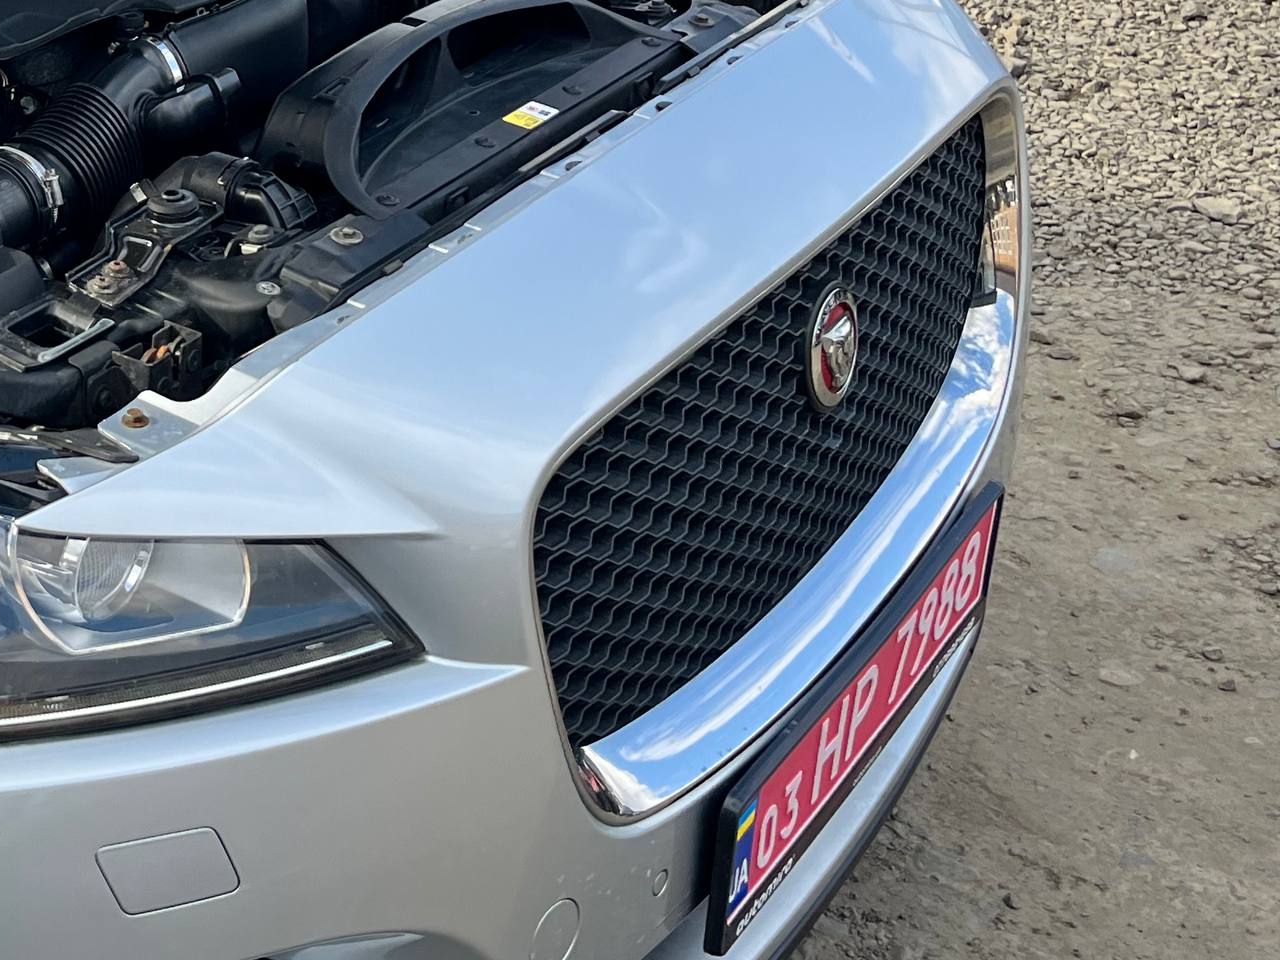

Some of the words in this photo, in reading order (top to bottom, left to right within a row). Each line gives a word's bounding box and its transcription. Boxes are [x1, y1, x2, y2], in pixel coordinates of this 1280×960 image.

[757, 770, 803, 869] 03
[811, 664, 879, 805] HP
[887, 531, 981, 705] 7988
